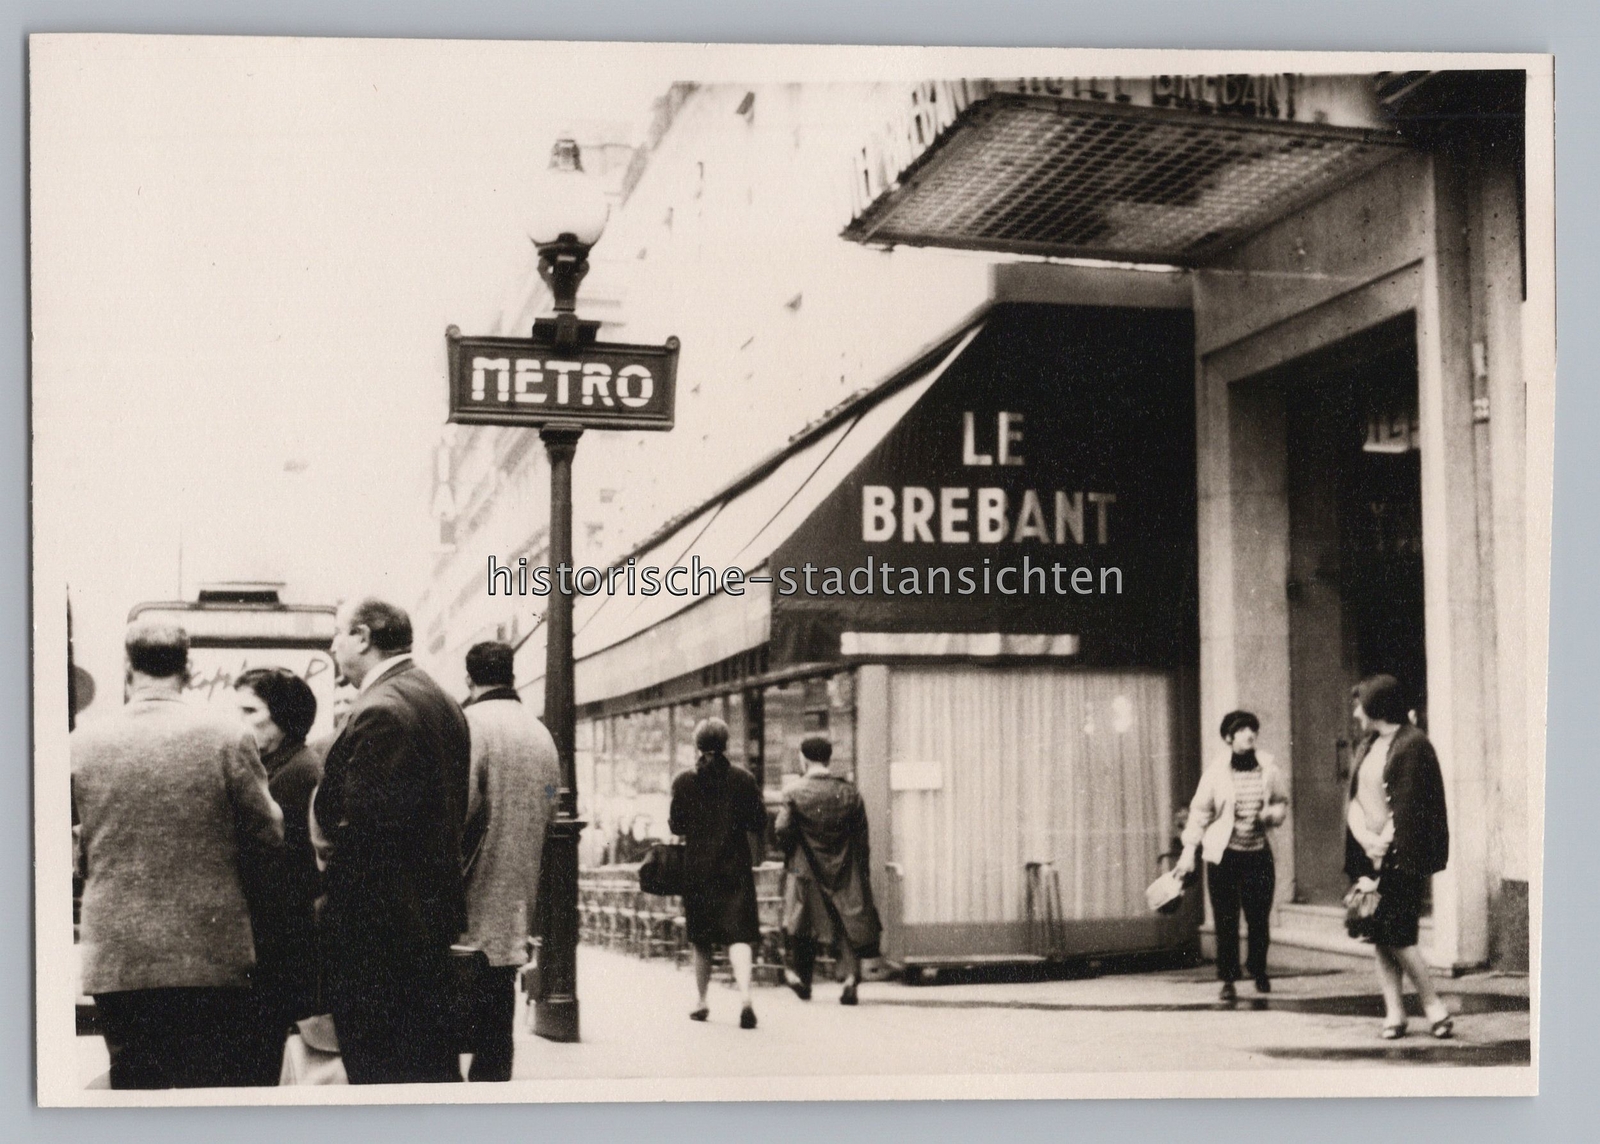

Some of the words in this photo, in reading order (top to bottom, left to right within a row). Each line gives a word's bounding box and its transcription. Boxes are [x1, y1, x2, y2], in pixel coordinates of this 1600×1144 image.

[471, 356, 654, 408] METRO
[962, 410, 1026, 466] LE
[861, 484, 1118, 545] BREBANT
